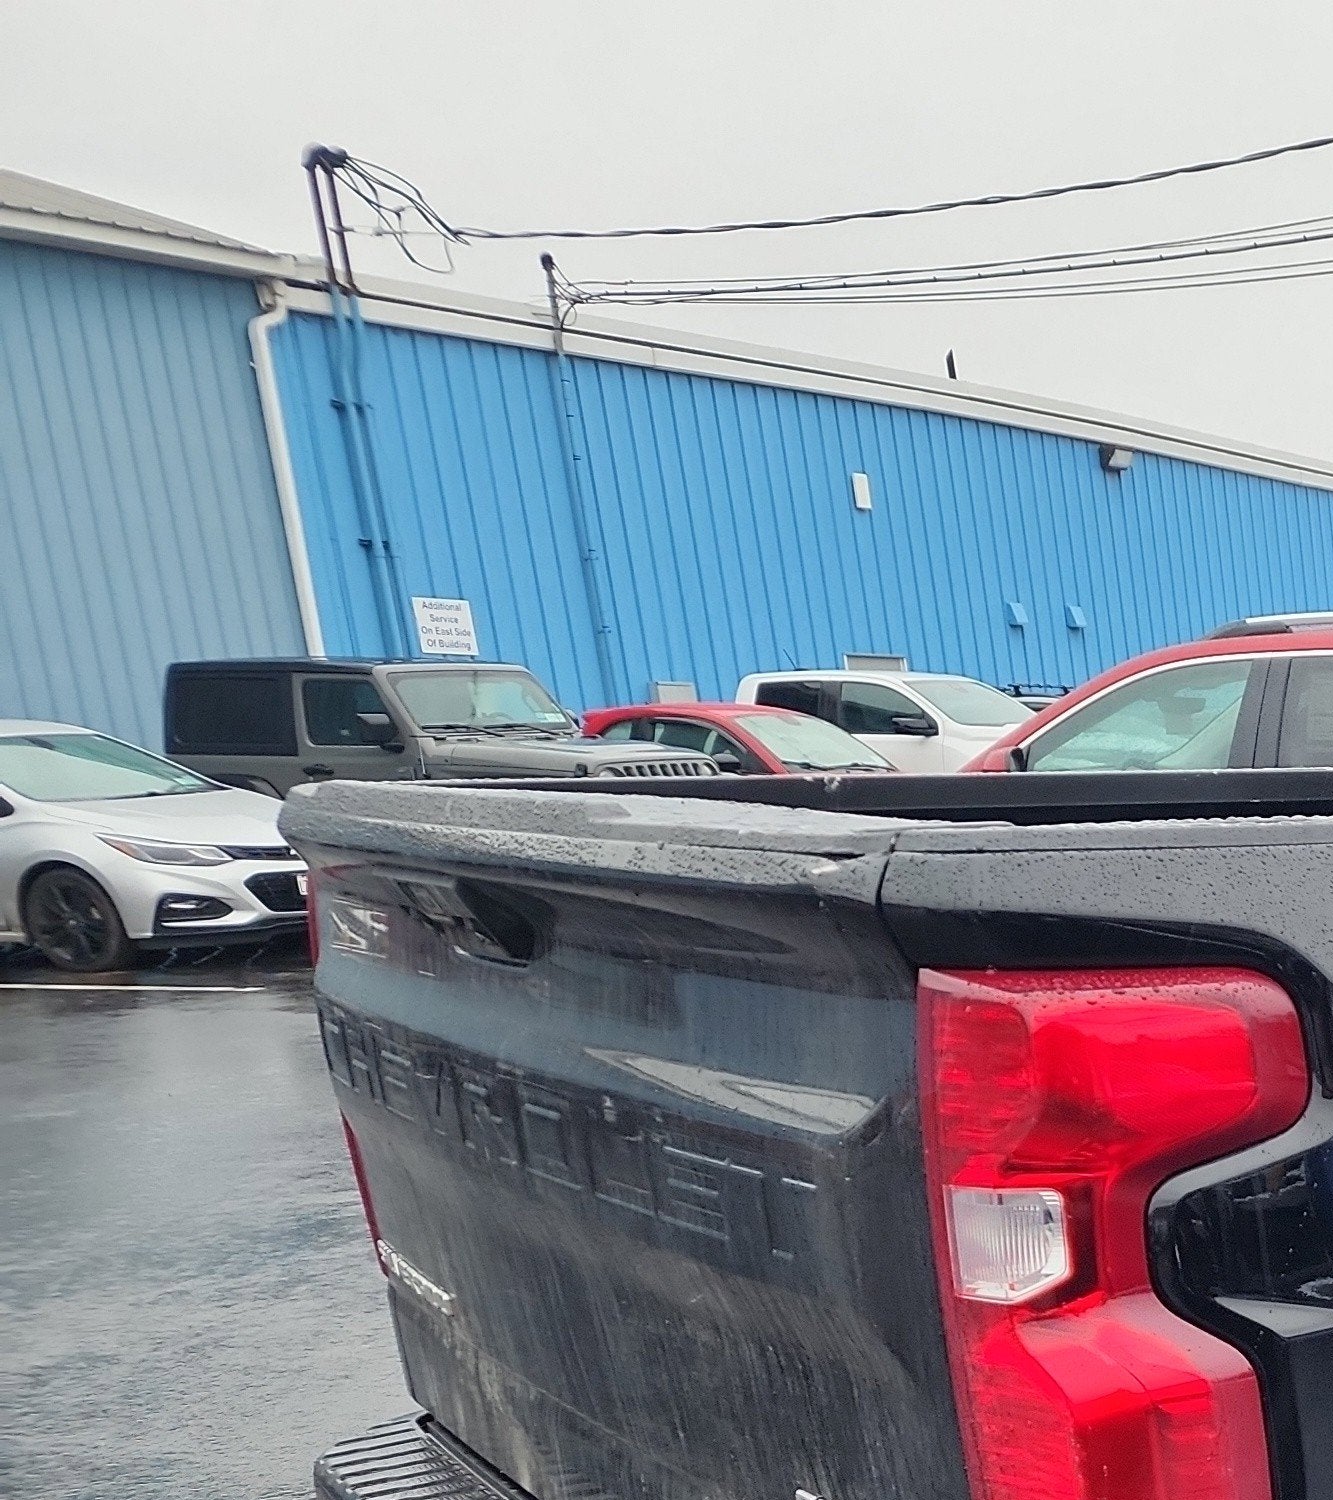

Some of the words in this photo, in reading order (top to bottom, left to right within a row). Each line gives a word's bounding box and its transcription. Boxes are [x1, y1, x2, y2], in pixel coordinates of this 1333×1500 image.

[422, 601, 462, 612] Additional
[429, 614, 459, 624] Service
[421, 625, 434, 635] On
[435, 627, 453, 636] East
[454, 627, 471, 637] Side
[427, 638, 437, 648] Of
[439, 639, 472, 652] Building
